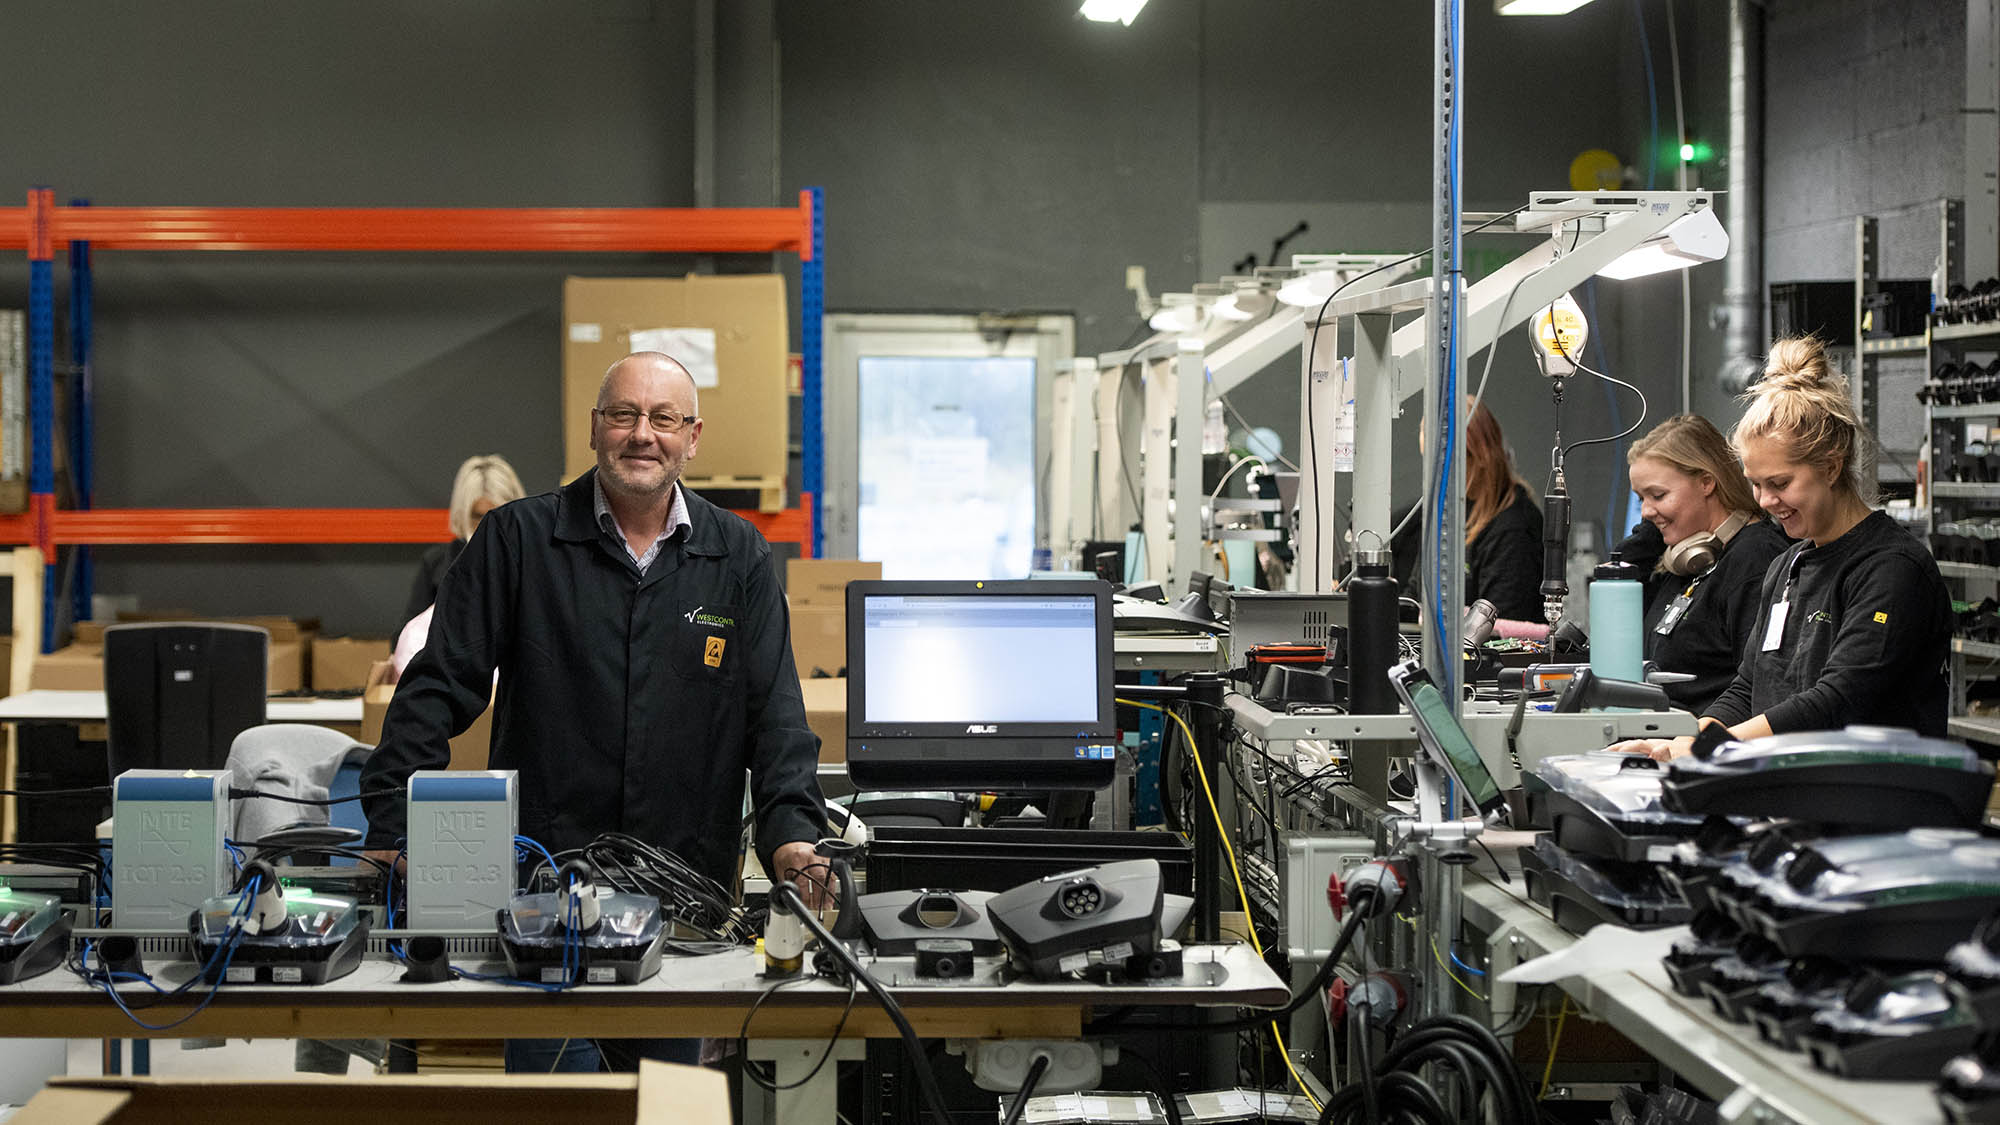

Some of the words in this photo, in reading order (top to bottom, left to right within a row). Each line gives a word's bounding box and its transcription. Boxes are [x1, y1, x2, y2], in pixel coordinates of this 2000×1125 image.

[966, 725, 998, 734] ASUS
[140, 810, 192, 832] MTE
[433, 810, 487, 832] MTE
[120, 864, 164, 885] ICT
[169, 864, 208, 885] 2.3
[416, 864, 459, 884] ICT
[465, 864, 502, 884] 2.3
